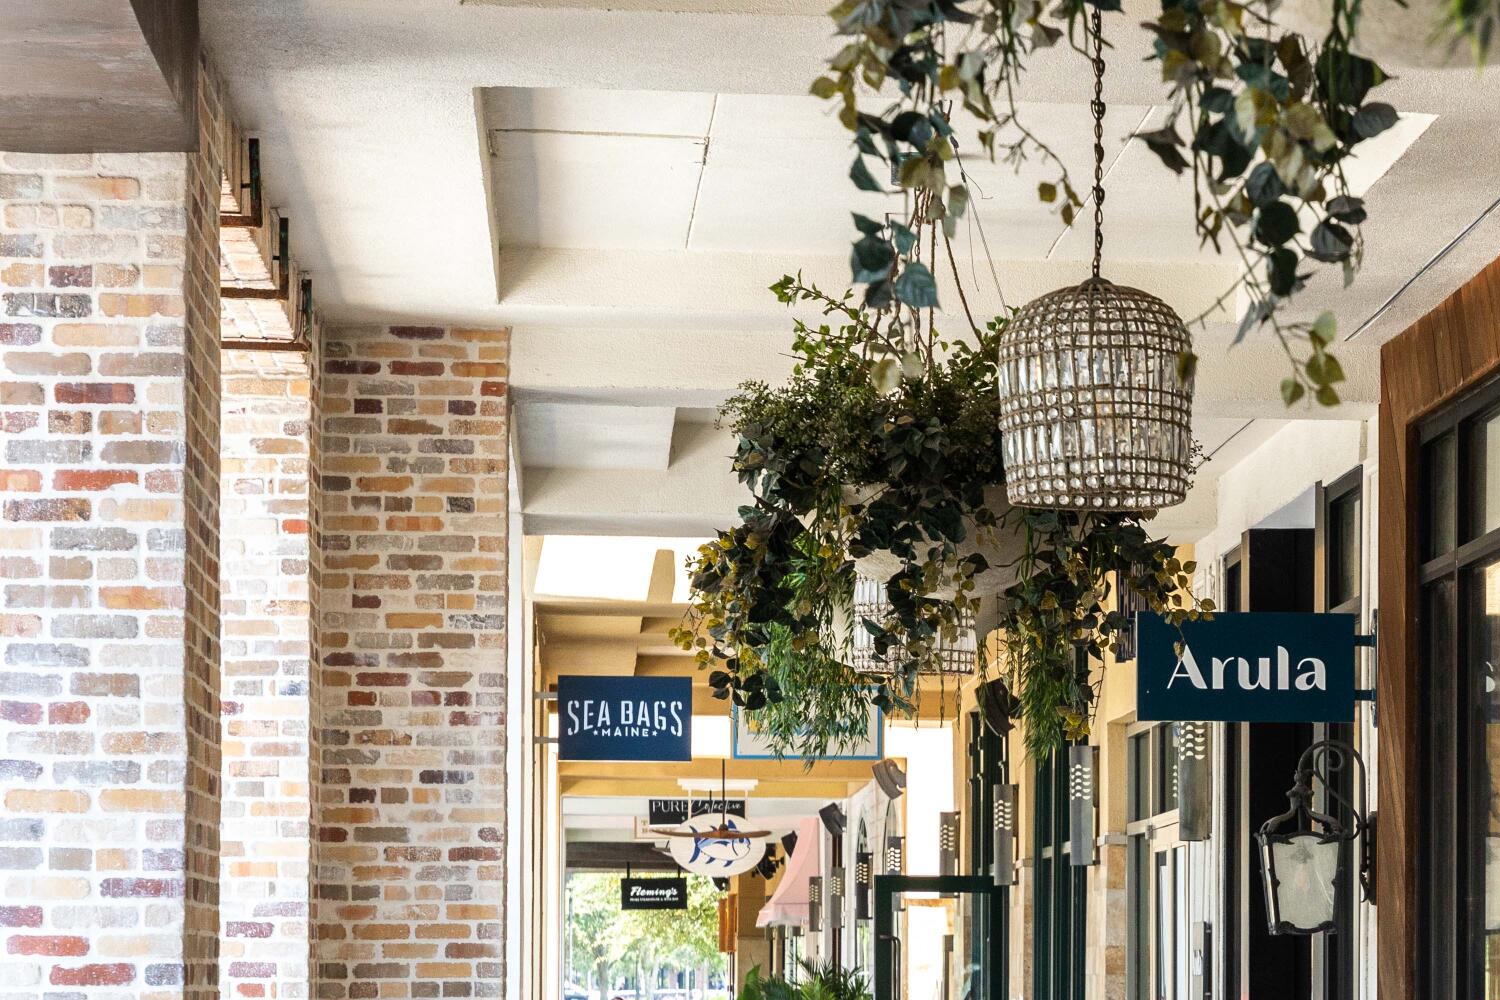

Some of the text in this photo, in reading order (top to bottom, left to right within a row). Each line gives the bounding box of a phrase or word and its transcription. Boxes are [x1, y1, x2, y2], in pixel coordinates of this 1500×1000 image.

[1167, 644, 1326, 691] Arula
[567, 700, 683, 737] SEA BAGS
[601, 727, 649, 737] MAINE
[652, 800, 689, 813] PURE
[630, 886, 678, 898] Fleming's
